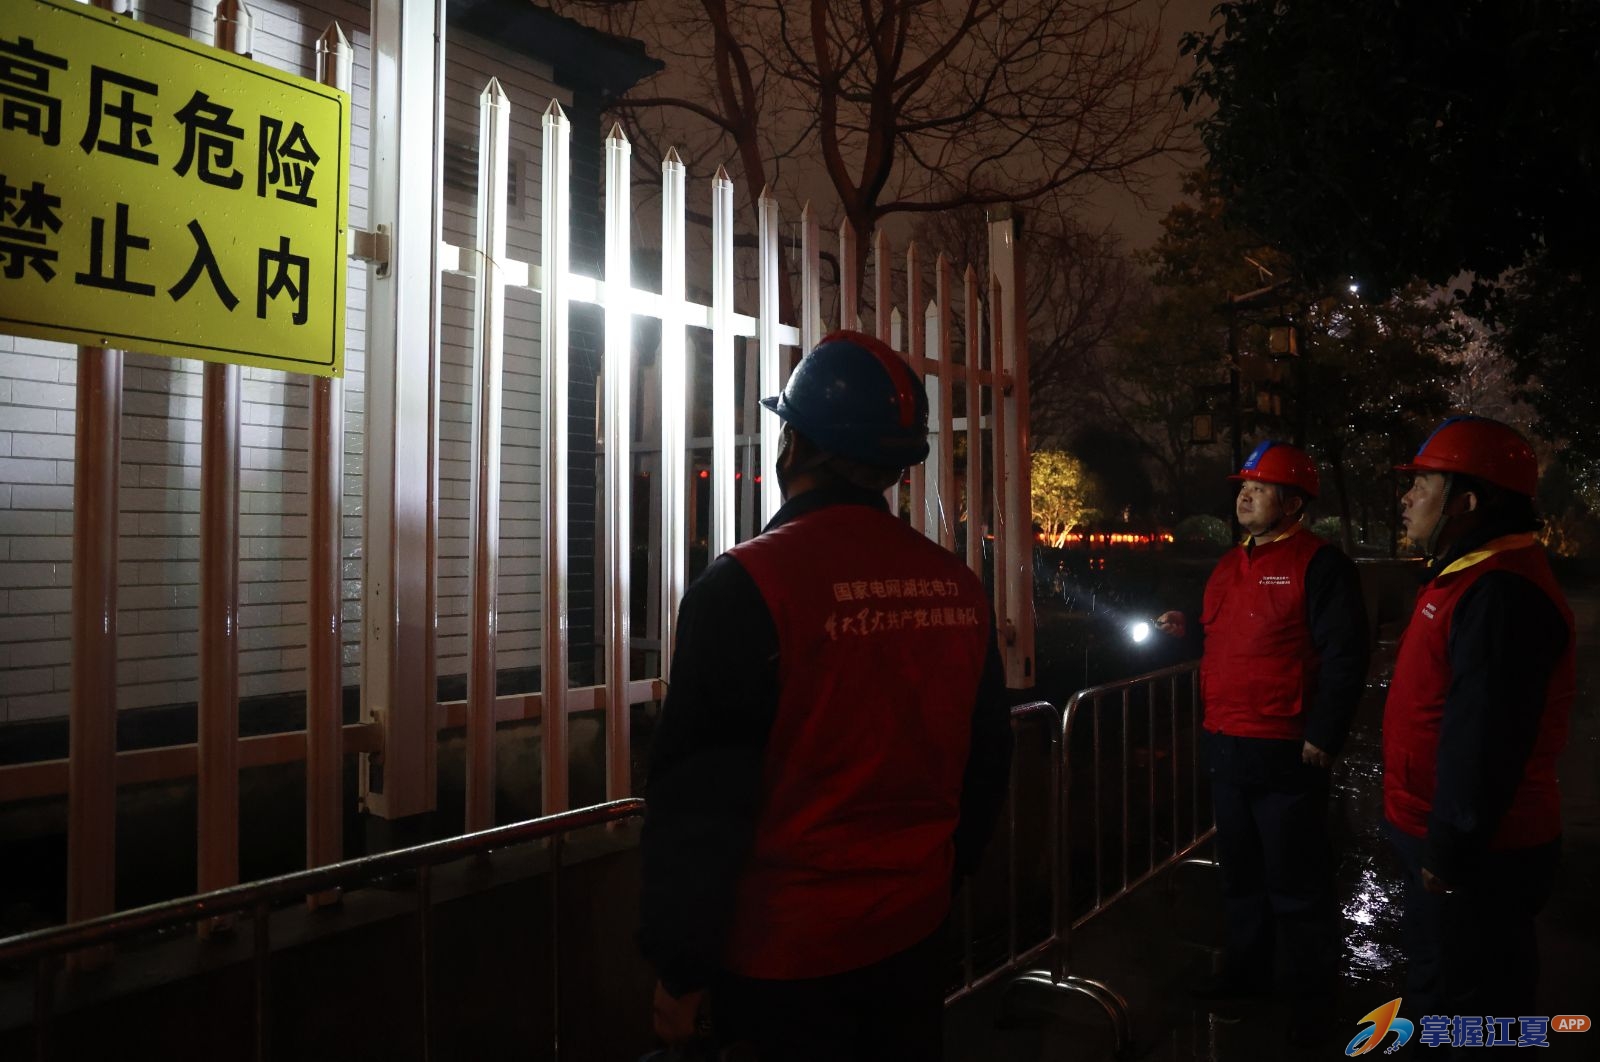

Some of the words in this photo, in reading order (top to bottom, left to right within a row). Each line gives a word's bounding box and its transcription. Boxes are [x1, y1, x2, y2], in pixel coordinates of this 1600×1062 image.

[0, 37, 321, 208] 高压危险
[0, 176, 309, 325] 禁止入内
[833, 580, 960, 602] 国家电网湖北电力
